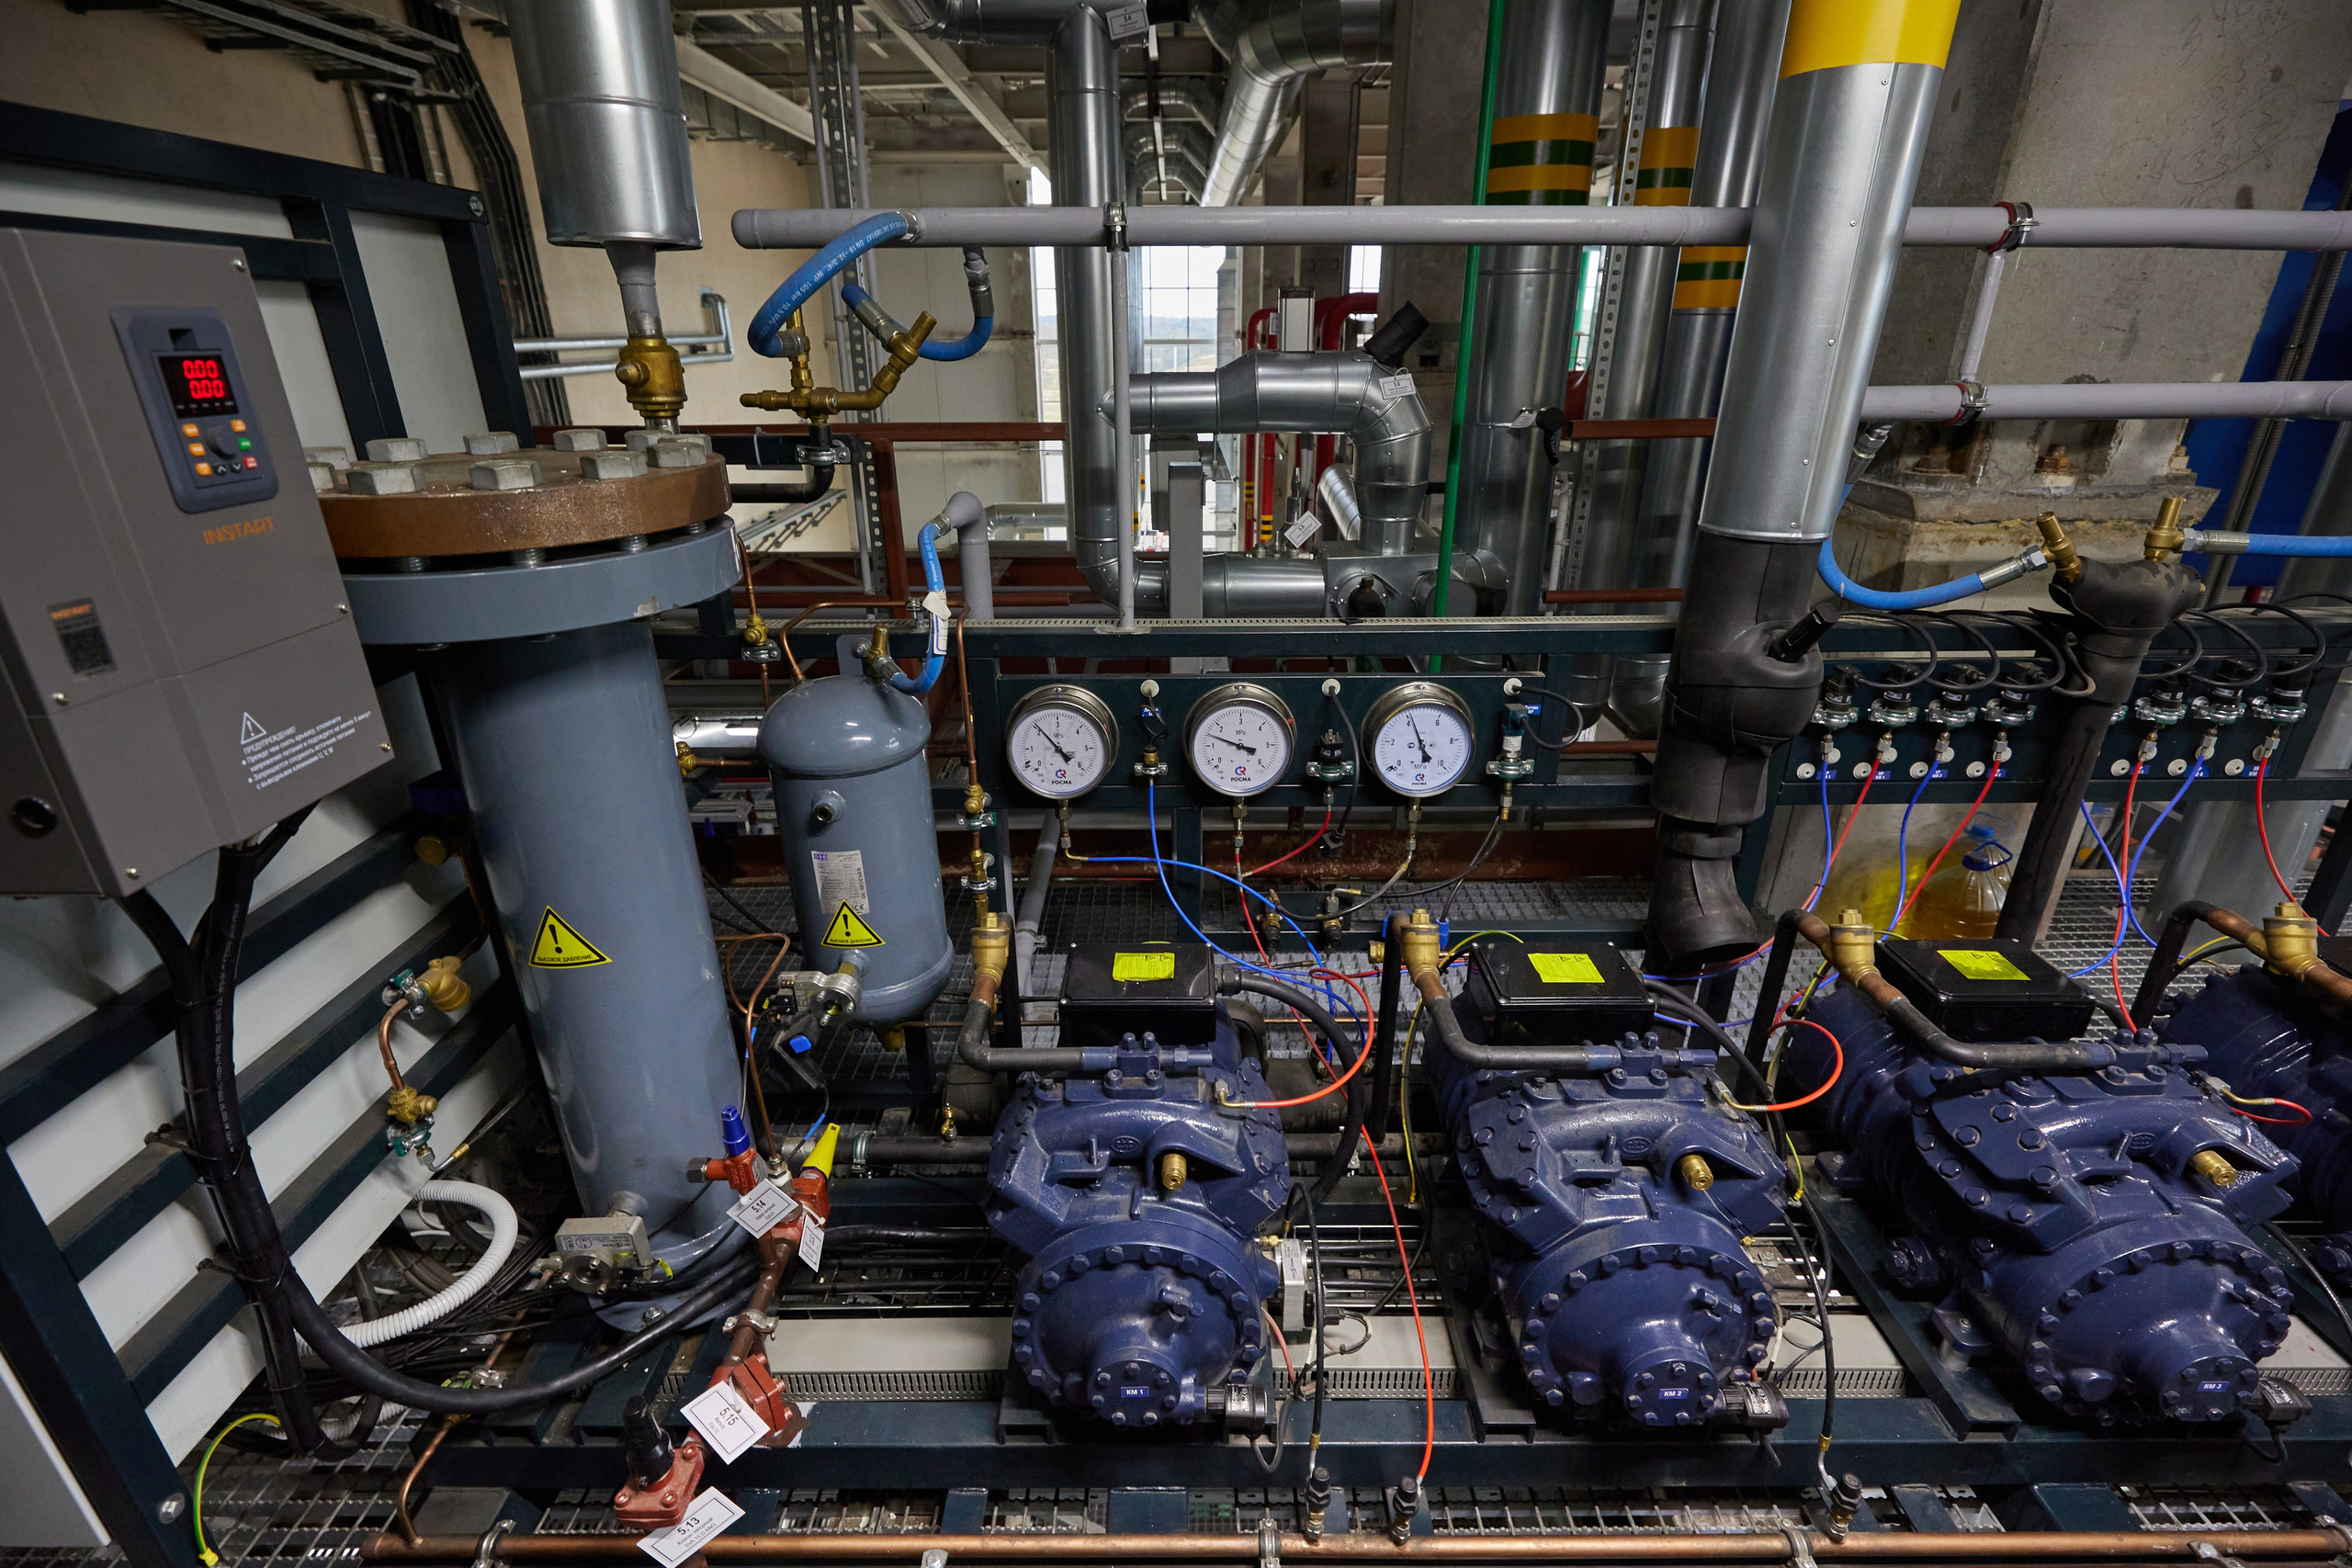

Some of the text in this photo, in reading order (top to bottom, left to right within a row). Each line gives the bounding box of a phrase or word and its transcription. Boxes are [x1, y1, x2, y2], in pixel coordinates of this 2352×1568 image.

[813, 271, 825, 282] WP
[791, 290, 801, 301] bar
[800, 281, 812, 293] 105
[203, 516, 275, 545] INSTART
[243, 726, 296, 755] ПРЕДУПРЕЖДЕНИЕ!
[247, 749, 269, 765] Прежде
[269, 745, 279, 753] чем
[280, 738, 295, 750] снять
[316, 716, 341, 732] отключите
[250, 753, 282, 773] напряжение
[282, 745, 303, 757] питания
[340, 720, 354, 730] менее
[357, 710, 371, 722] минут
[253, 762, 288, 781] Запрещается
[563, 954, 592, 962] ДАВЛЕНИЕ
[751, 1200, 766, 1213] 5.14
[720, 1407, 739, 1425] 5.15
[677, 1517, 700, 1535] 5.13
